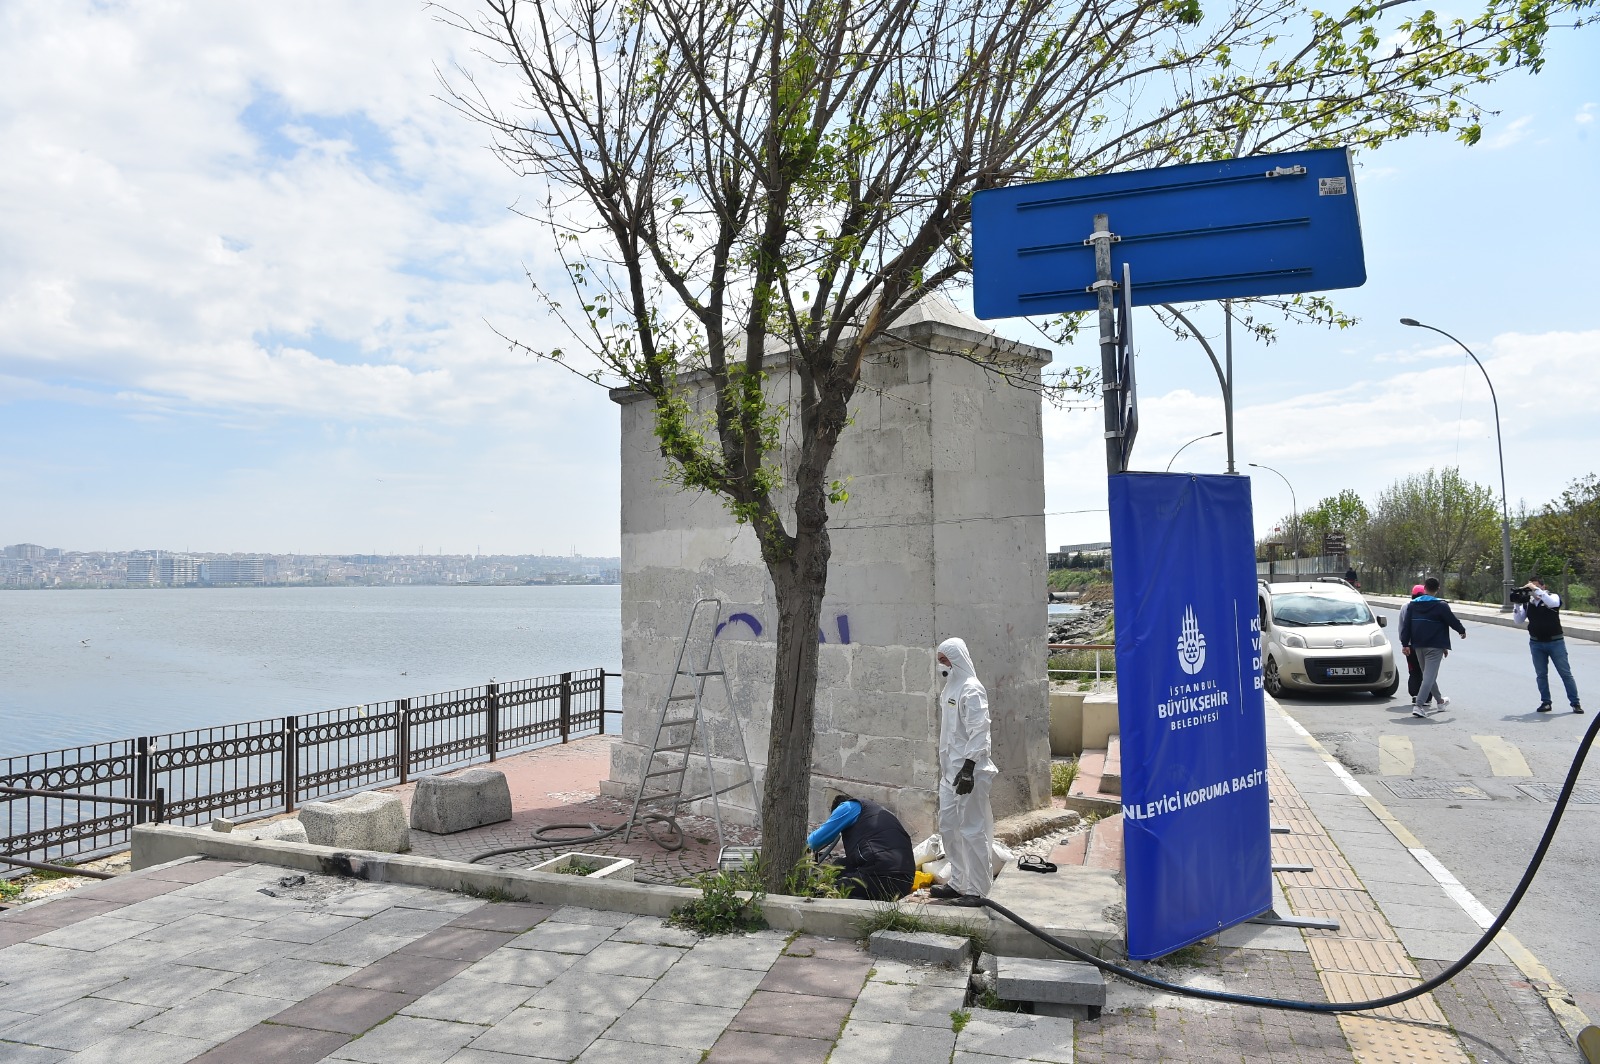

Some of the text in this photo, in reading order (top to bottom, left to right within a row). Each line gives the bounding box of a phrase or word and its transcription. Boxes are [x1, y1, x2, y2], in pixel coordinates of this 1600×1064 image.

[1169, 679, 1217, 697] İSTANBUL
[1157, 689, 1229, 719] BÜYÜKŞEHİR
[1170, 709, 1219, 731] BELEDİYESİ
[1183, 780, 1231, 808] KORUMA
[1231, 768, 1263, 793] BASİT
